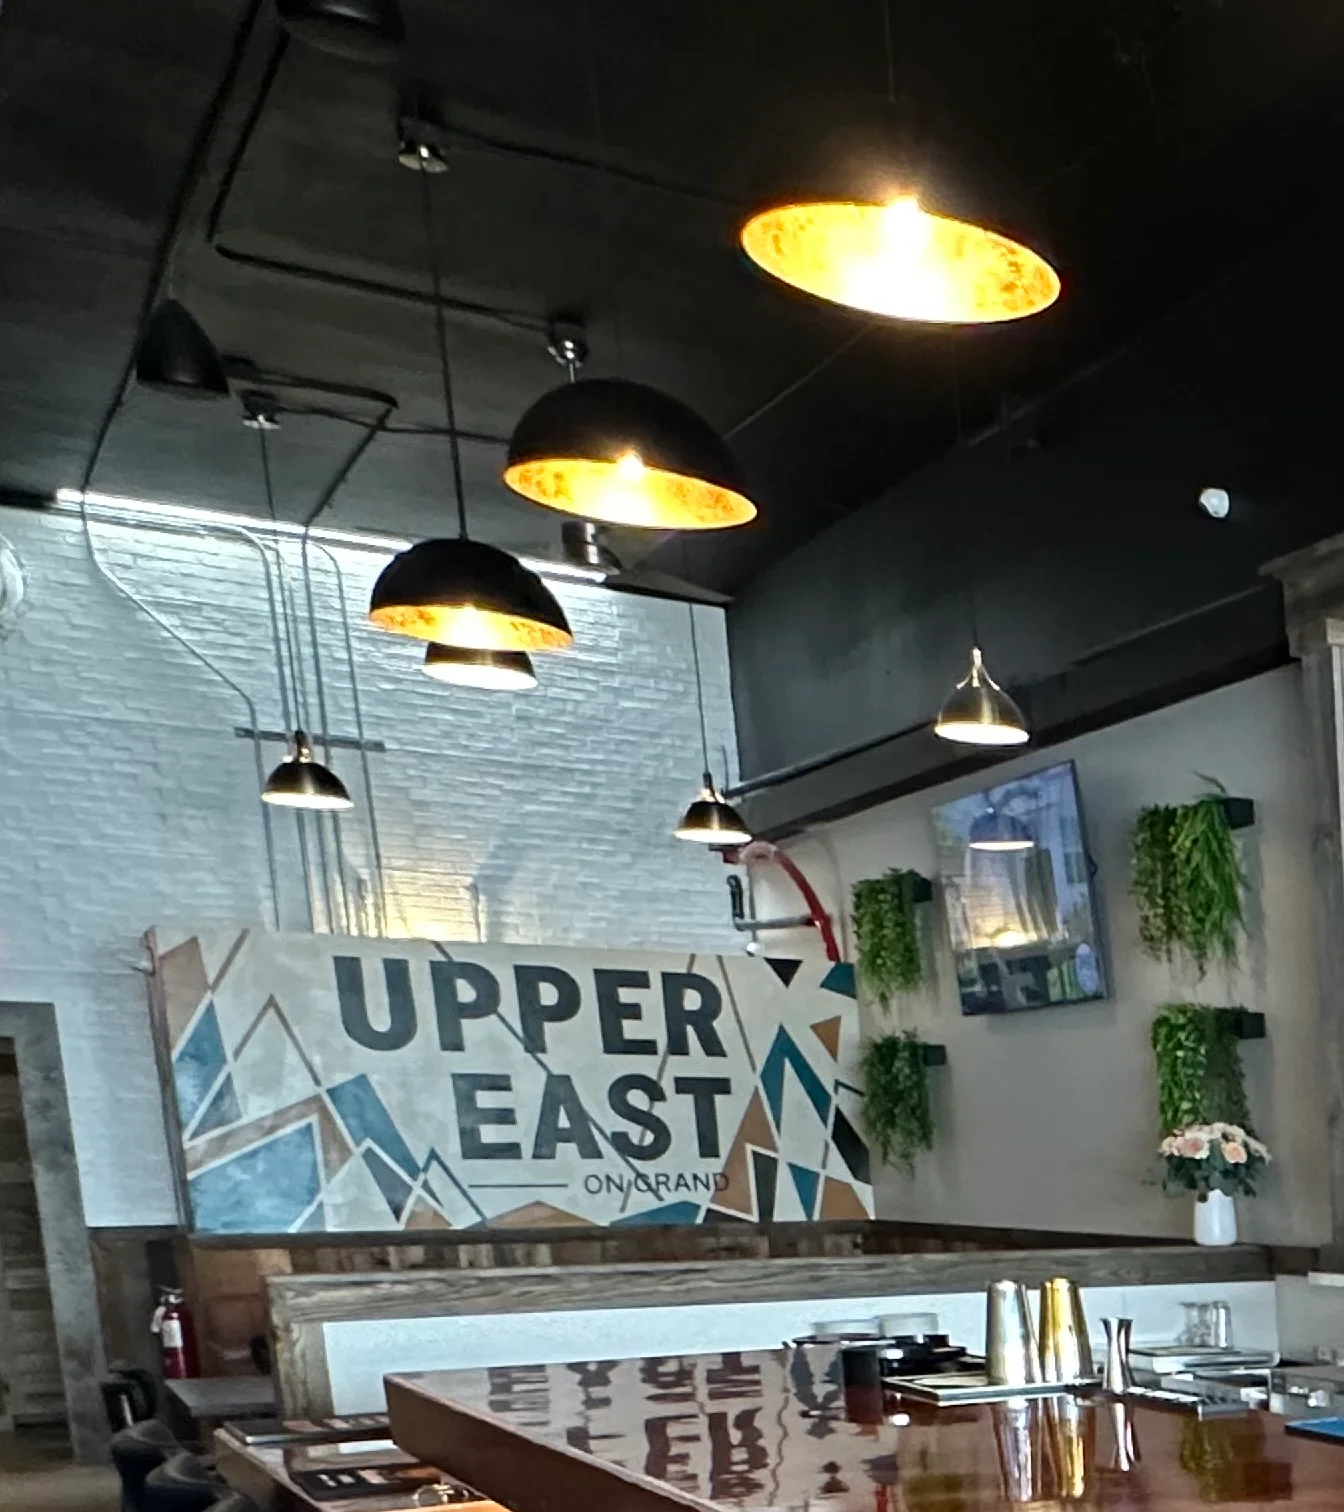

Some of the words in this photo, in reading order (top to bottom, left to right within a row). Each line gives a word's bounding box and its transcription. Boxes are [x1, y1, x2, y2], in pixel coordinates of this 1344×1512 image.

[332, 954, 729, 1058] UPPER
[450, 1072, 732, 1161] EAST
[584, 1172, 624, 1195] ON
[633, 1171, 730, 1194] GRAND
